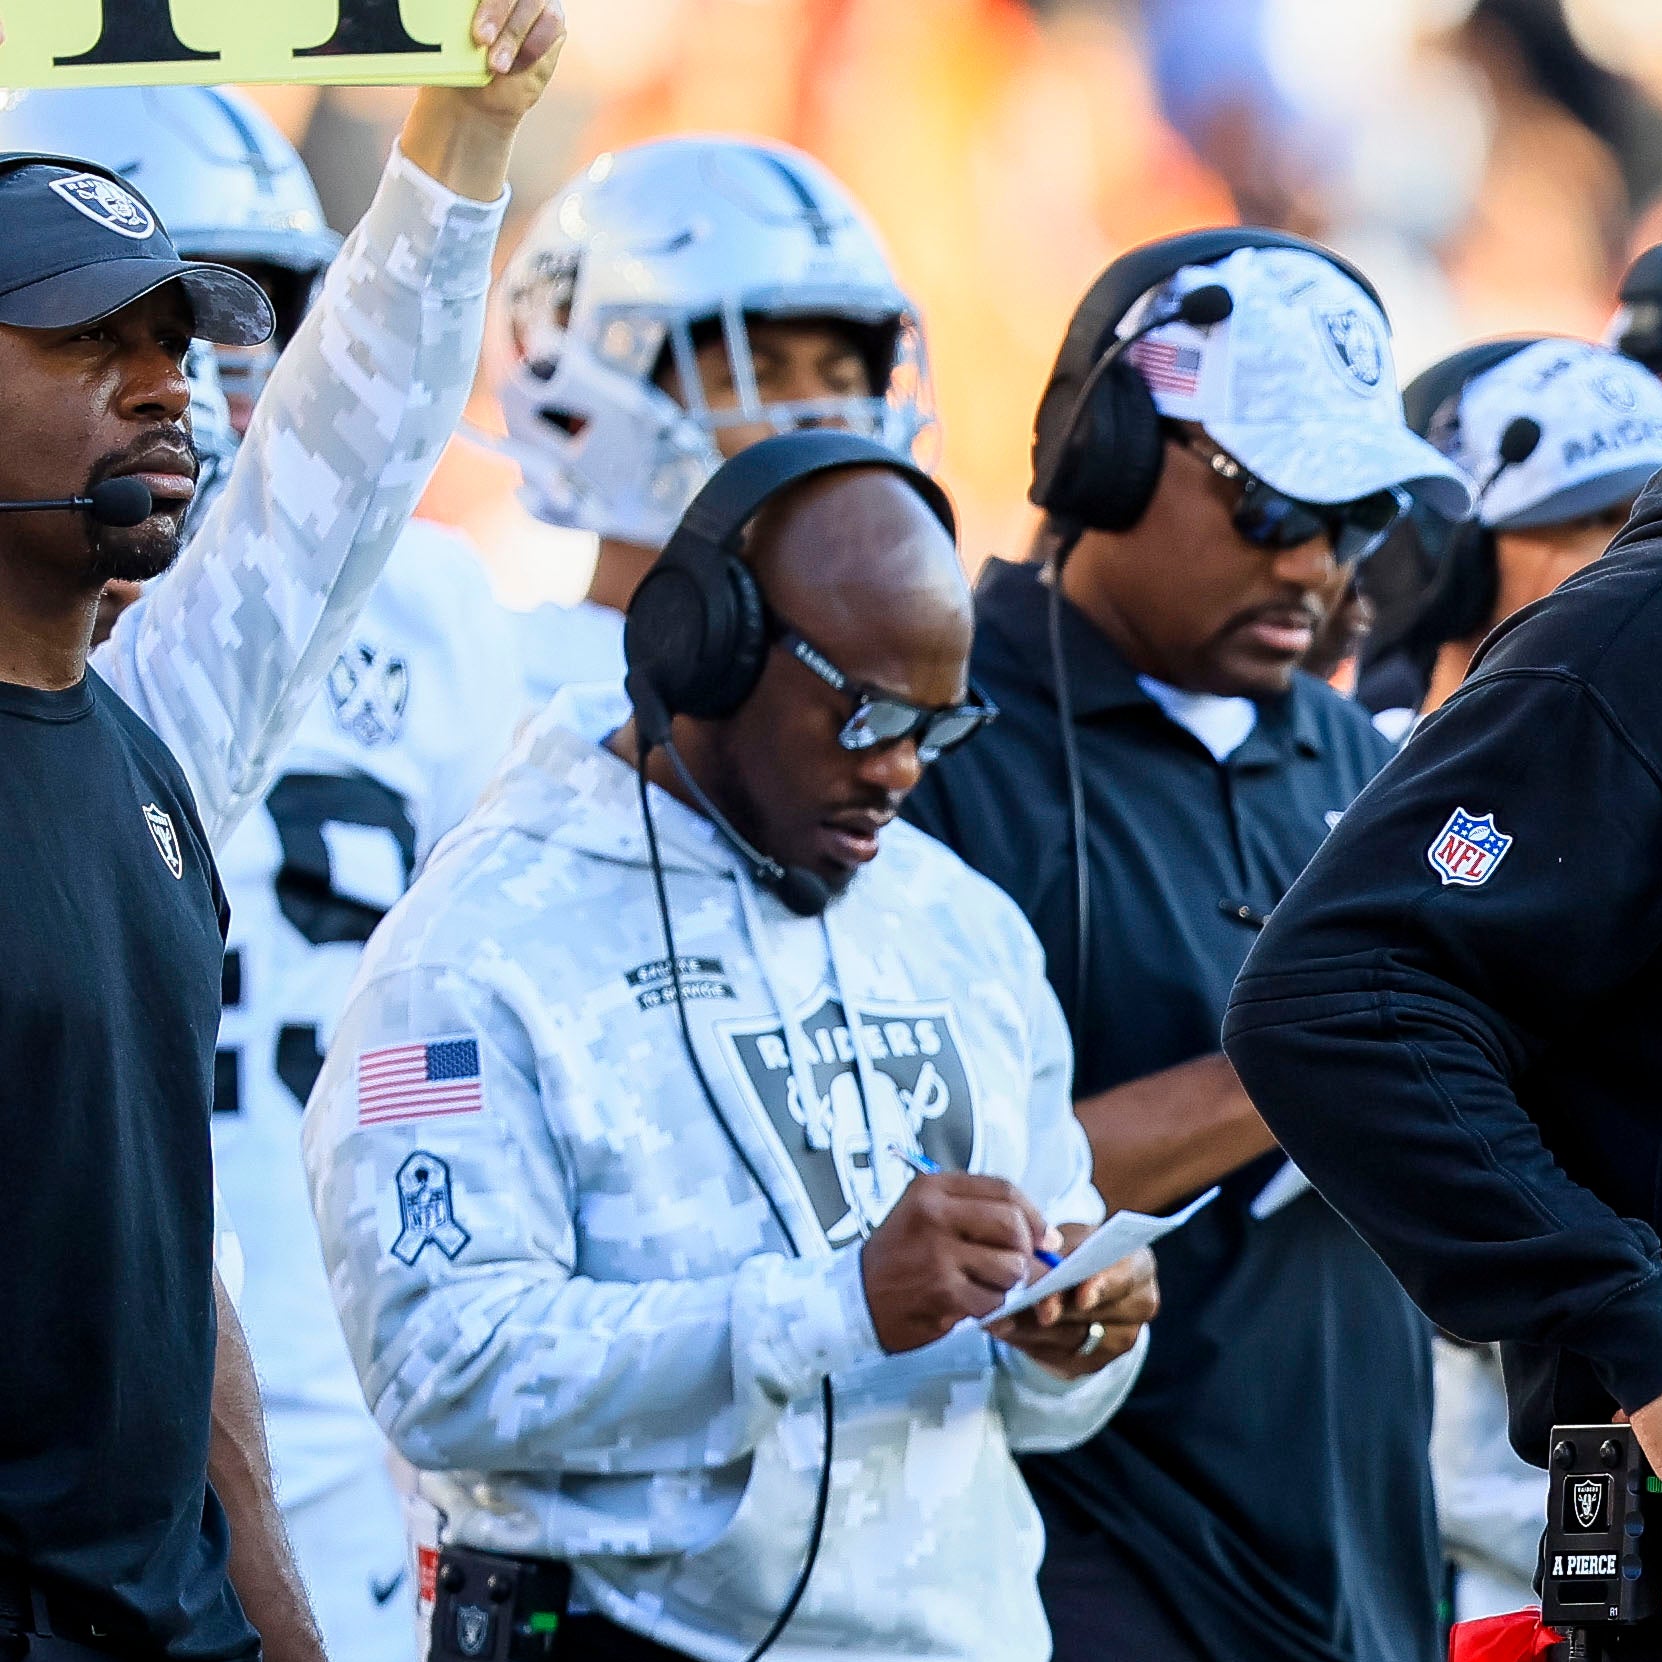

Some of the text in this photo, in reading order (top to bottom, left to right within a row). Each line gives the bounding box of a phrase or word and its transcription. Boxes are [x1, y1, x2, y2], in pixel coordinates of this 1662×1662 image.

[1437, 834, 1487, 878] NFL
[756, 1019, 942, 1070] RIDERS
[1552, 1554, 1617, 1576] A PIERCE
